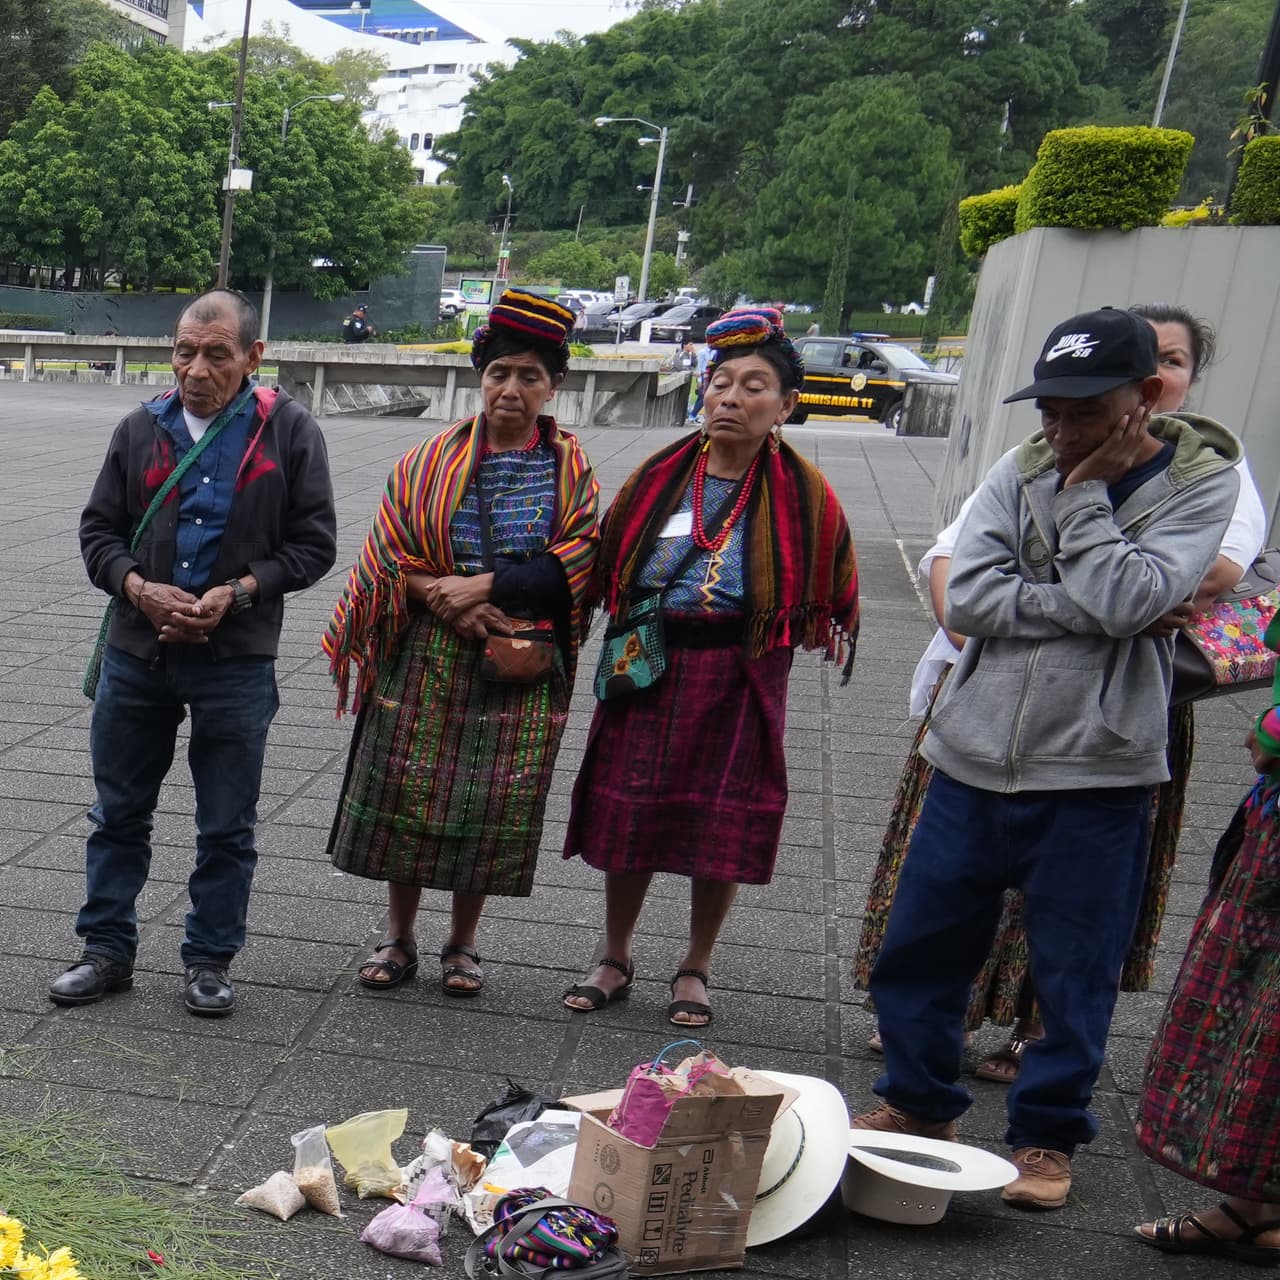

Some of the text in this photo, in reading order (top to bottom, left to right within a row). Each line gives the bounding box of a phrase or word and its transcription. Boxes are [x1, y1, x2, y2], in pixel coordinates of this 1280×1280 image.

[1059, 334, 1090, 349] NIKE
[1071, 348, 1093, 358] SB
[861, 397, 874, 409] 11
[701, 1166, 710, 1194] Abbott
[672, 1170, 698, 1254] Pedialyte
